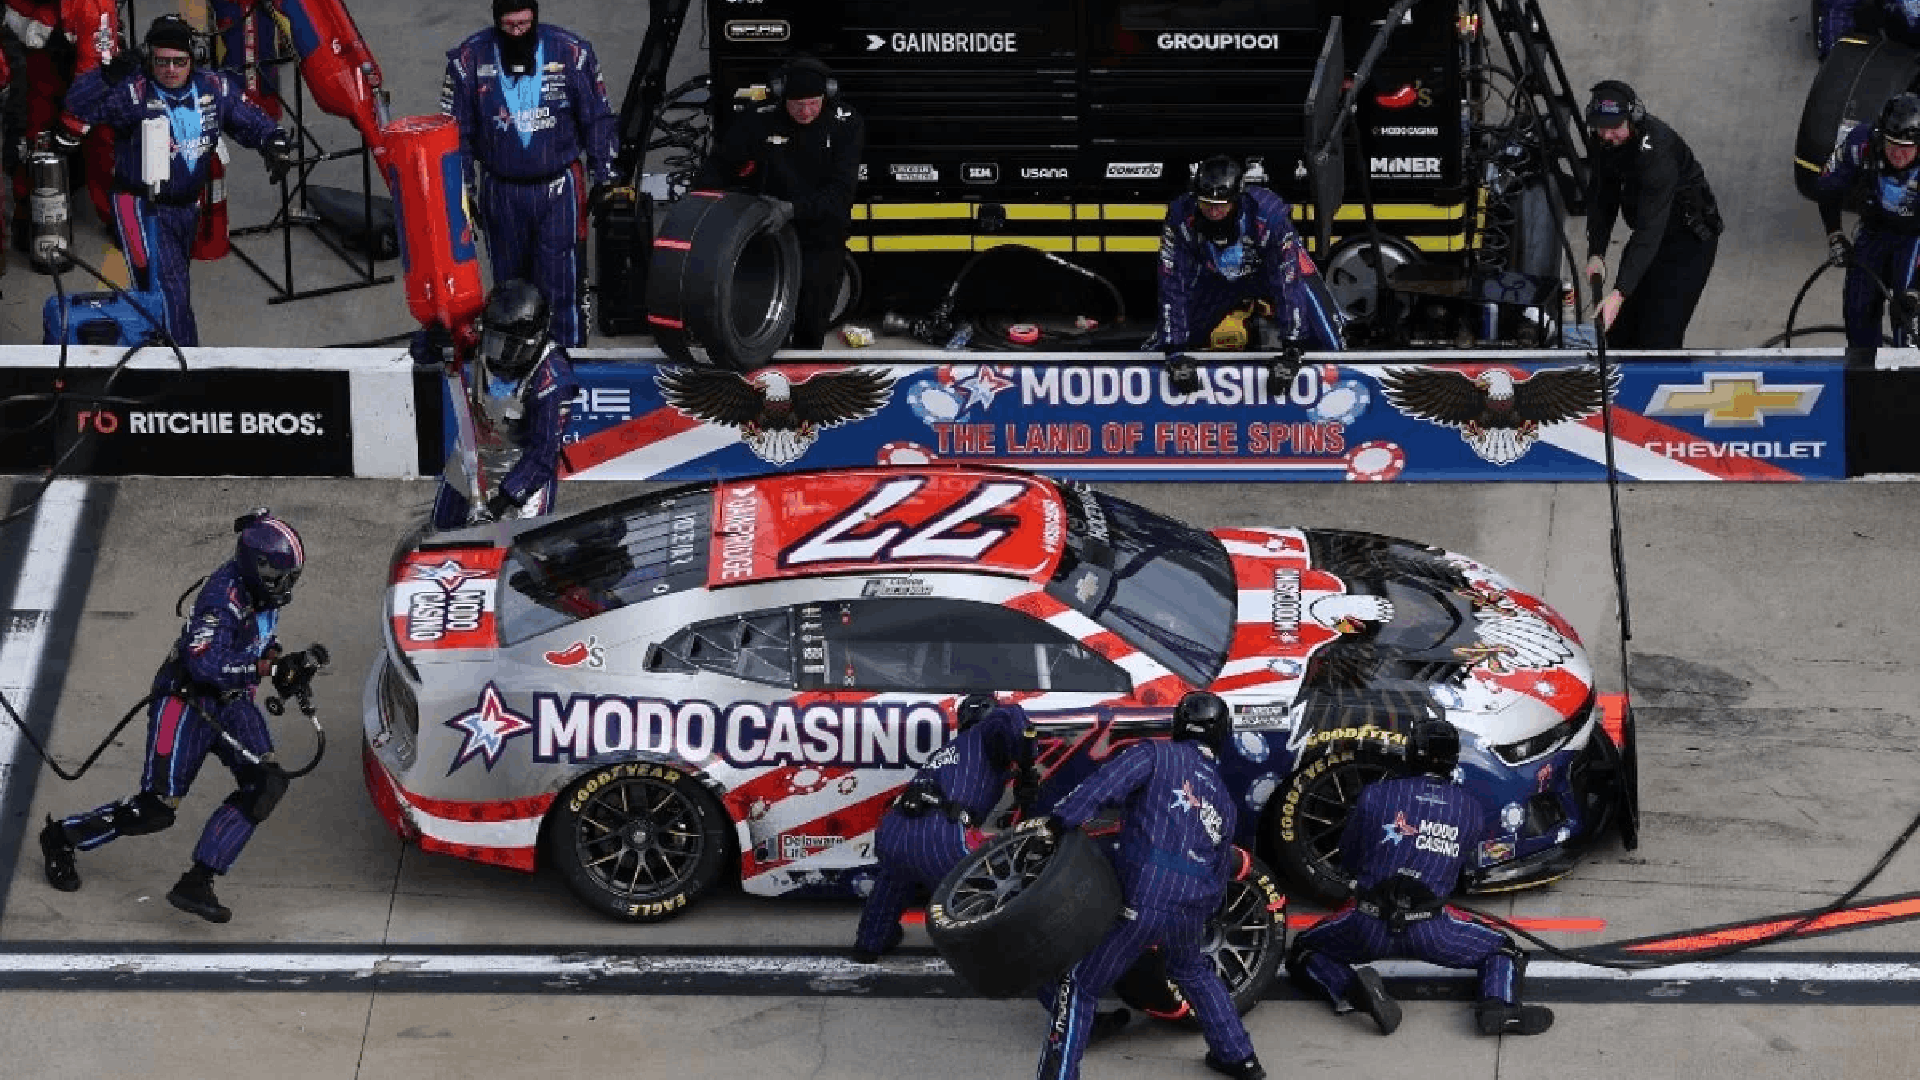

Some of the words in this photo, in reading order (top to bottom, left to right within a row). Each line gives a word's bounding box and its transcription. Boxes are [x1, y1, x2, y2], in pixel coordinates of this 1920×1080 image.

[892, 33, 1017, 53] GAINBRIDGE
[1157, 34, 1279, 50] GROUP1001
[1021, 168, 1068, 178] USANA
[1371, 158, 1441, 173] MINER
[1021, 367, 1151, 406] MODO
[129, 412, 234, 434] RITCHIE
[240, 412, 324, 435] BROS.
[933, 422, 996, 454] THE
[1005, 422, 1091, 454] LAND
[1101, 422, 1143, 454] OF
[1155, 422, 1238, 454] FREE
[1247, 422, 1346, 454] SPINS
[1644, 441, 1828, 458] CHEVROLET
[409, 592, 447, 641] CASINO
[446, 590, 486, 631] MODO
[536, 696, 718, 762] MODO
[725, 702, 944, 767] CASINO
[569, 763, 681, 812] GOODYEAR
[1418, 819, 1459, 841] MODO
[1415, 835, 1460, 858] CASINO
